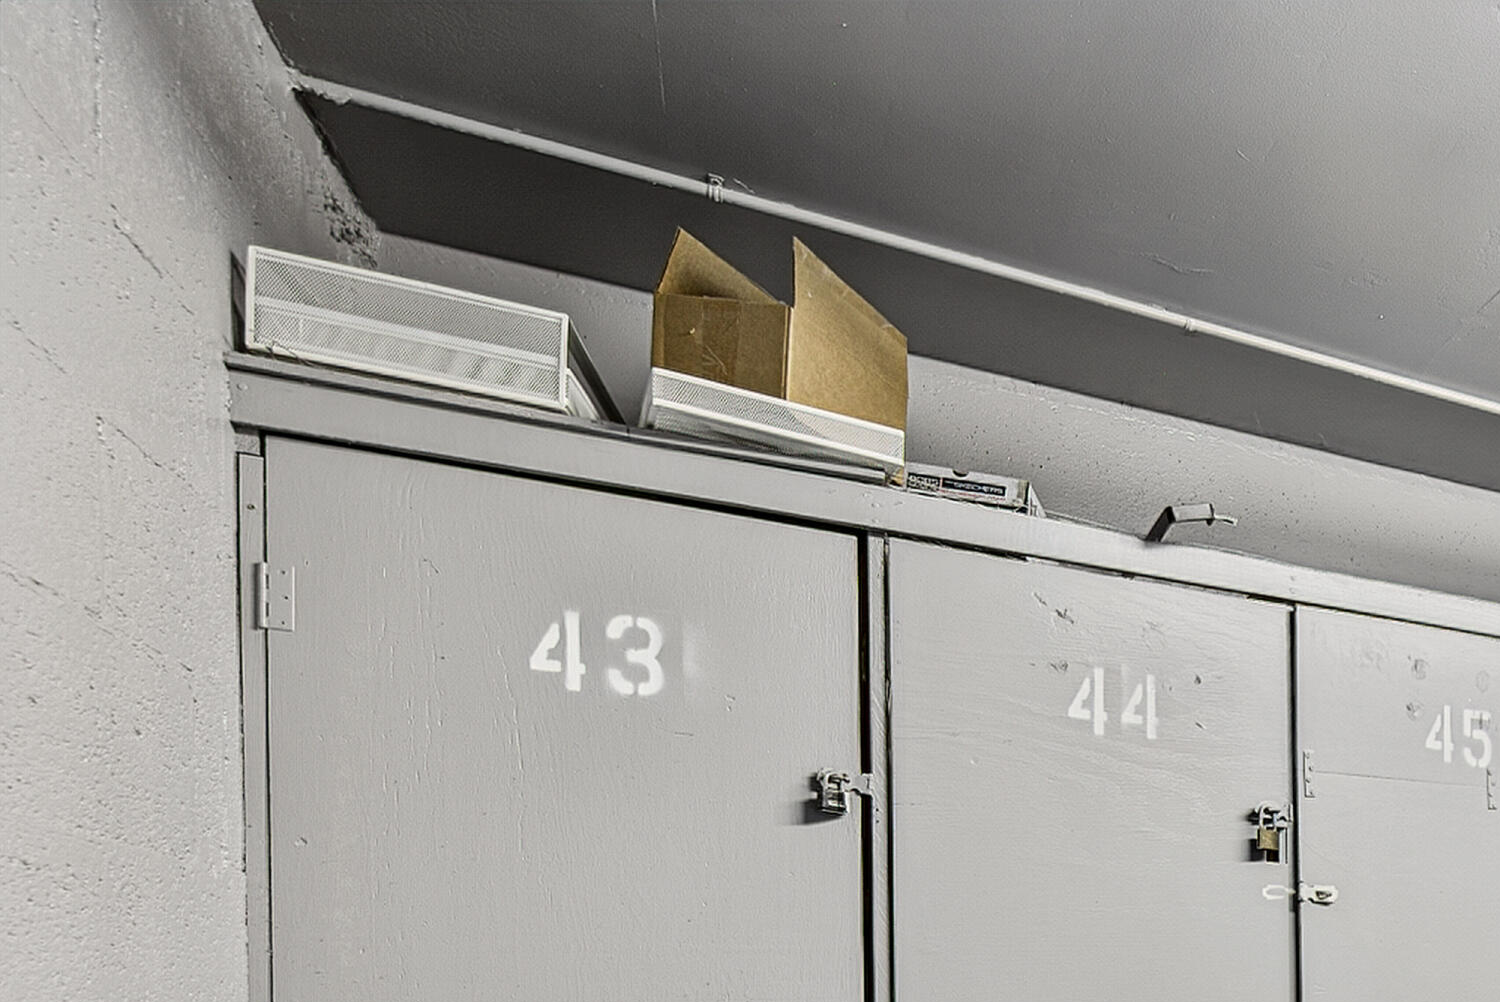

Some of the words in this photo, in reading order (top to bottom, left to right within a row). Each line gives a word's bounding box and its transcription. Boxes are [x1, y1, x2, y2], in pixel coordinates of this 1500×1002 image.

[529, 611, 664, 695] 43
[1068, 667, 1159, 740] 44
[1425, 704, 1492, 769] 45
